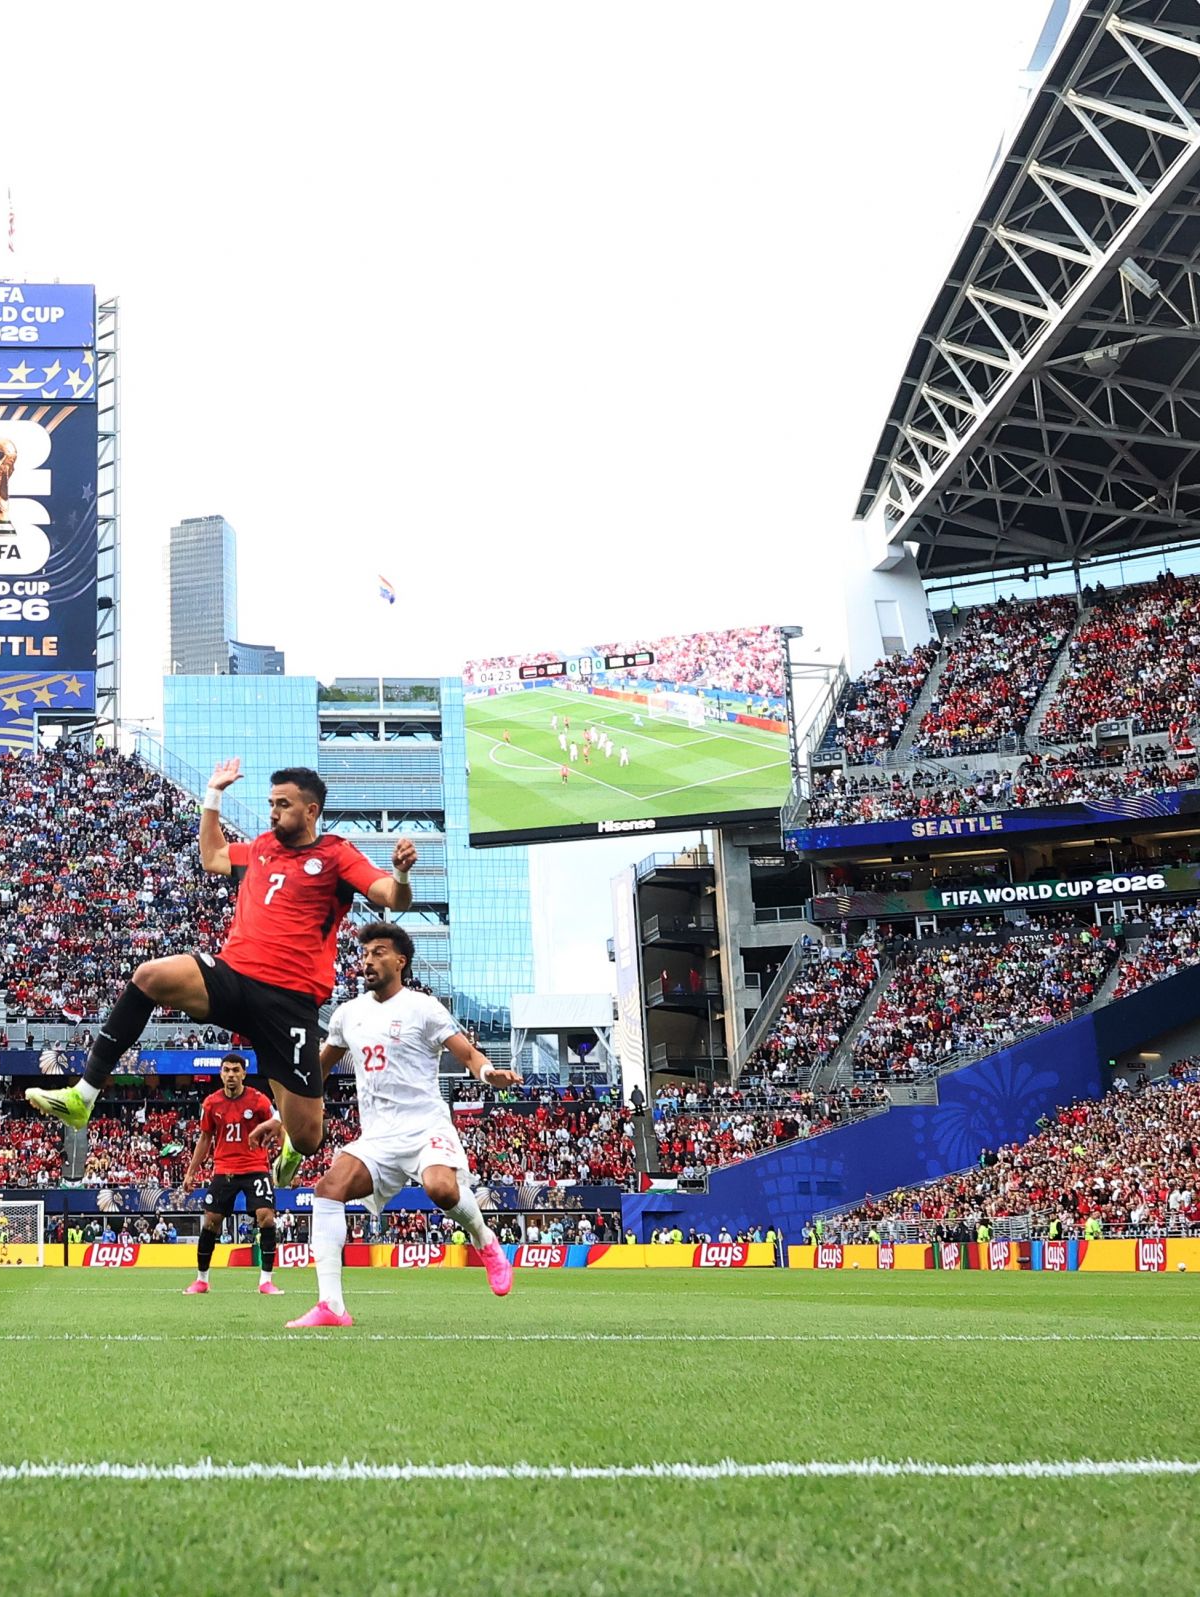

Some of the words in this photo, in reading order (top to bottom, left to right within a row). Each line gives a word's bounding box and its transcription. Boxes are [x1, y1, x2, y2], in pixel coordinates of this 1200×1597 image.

[21, 306, 65, 323] CUP
[12, 581, 50, 596] CUP
[480, 670, 512, 684] 04:23
[1098, 721, 1129, 733] 301
[811, 751, 842, 763] 300
[597, 819, 656, 833] Hisense
[911, 815, 1004, 838] SEATTLE
[264, 873, 286, 905] 7
[941, 889, 983, 906] FIFA
[983, 884, 1053, 904] WORLD
[1055, 880, 1092, 898] CUP
[1096, 873, 1166, 895] 2026
[290, 1027, 307, 1065] 7
[362, 1044, 388, 1072] 23
[225, 1122, 242, 1142] 21
[253, 1176, 273, 1197] 21
[90, 1243, 133, 1267] Lay's
[398, 1244, 441, 1267] Lay's
[520, 1244, 561, 1268] Lay's
[700, 1243, 743, 1267] Lay's
[818, 1244, 842, 1269] Lay's
[879, 1243, 894, 1269] Lay's
[939, 1242, 959, 1270] Lay's
[989, 1241, 1009, 1271] Lay's
[1044, 1240, 1065, 1271] Lay's
[1138, 1238, 1164, 1272] Lay's
